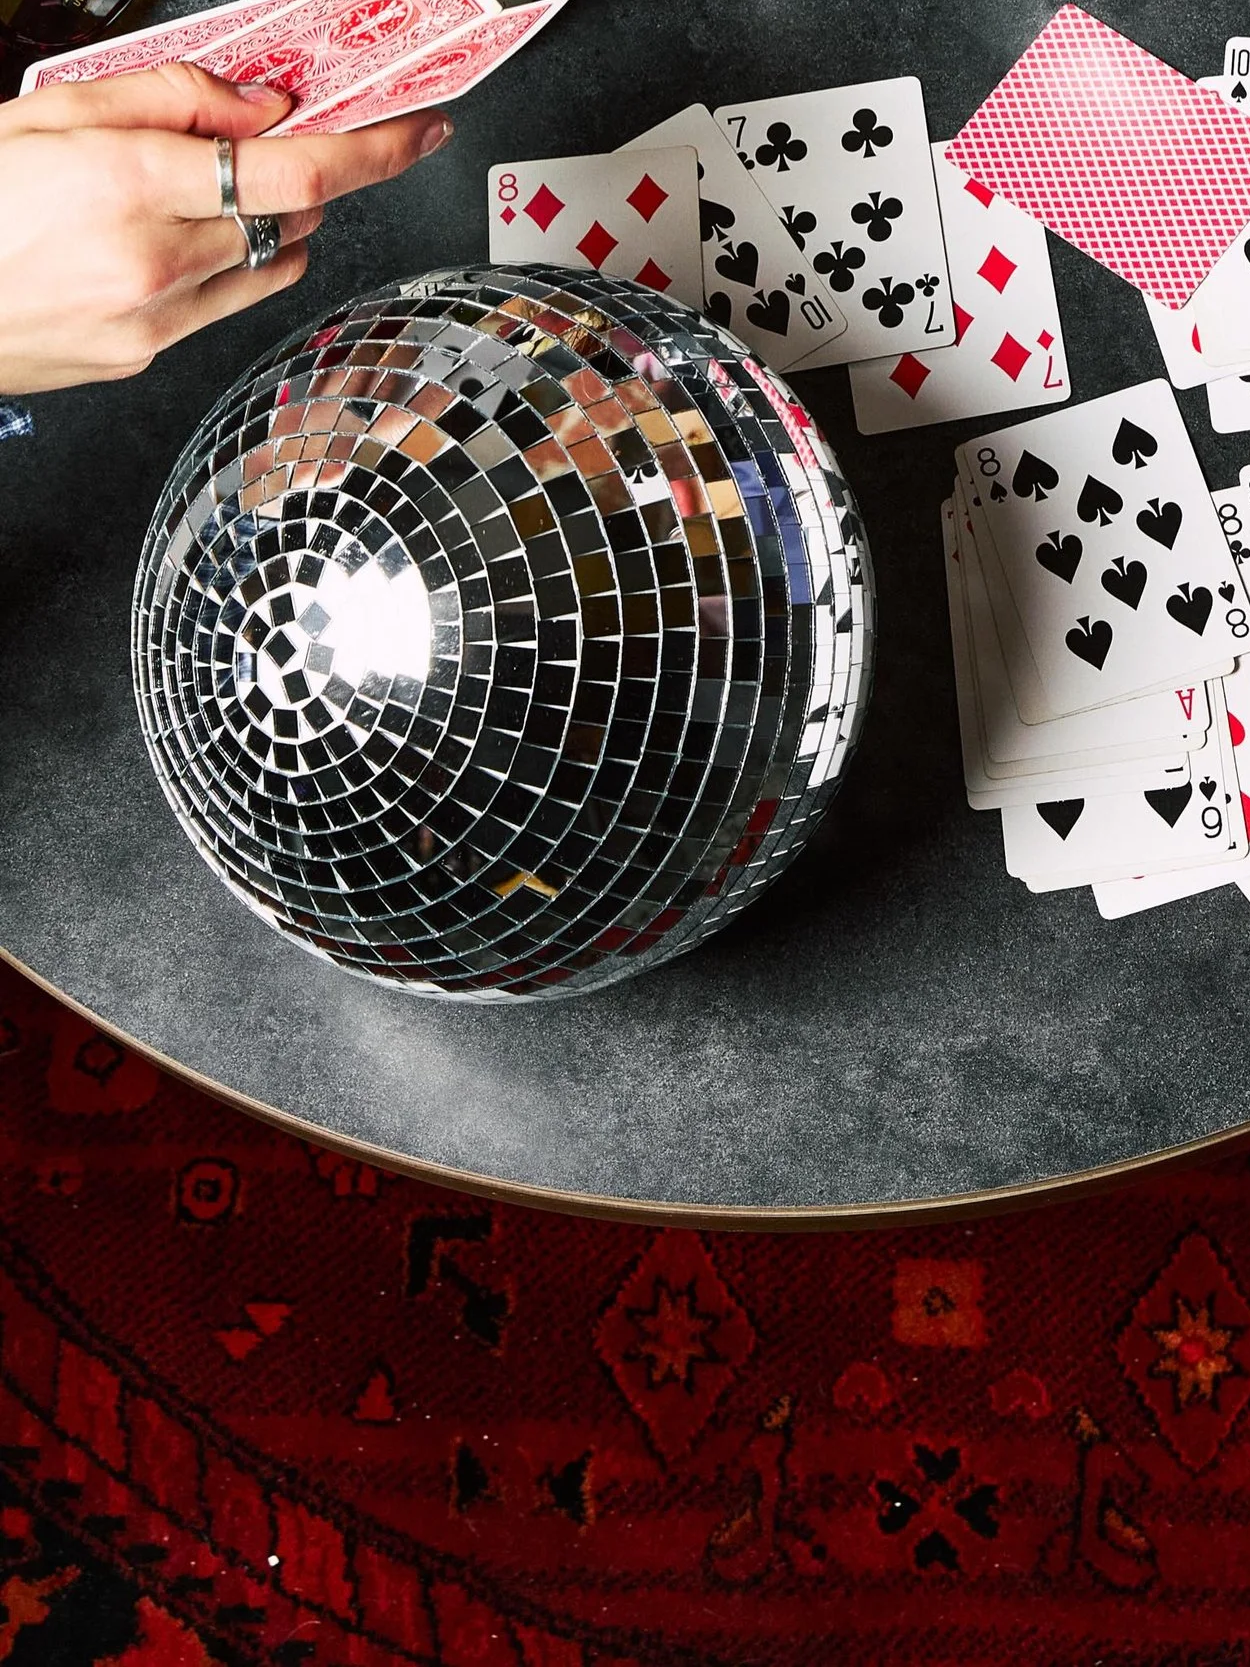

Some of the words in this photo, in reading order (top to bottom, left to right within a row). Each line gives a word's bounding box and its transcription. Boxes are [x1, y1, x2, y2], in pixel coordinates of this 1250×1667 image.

[1230, 48, 1250, 77] 10
[727, 116, 747, 149] 7
[498, 173, 519, 202] 8
[800, 295, 833, 331] 10
[924, 301, 944, 334] 7
[1043, 355, 1063, 389] 7
[977, 447, 1001, 477] 8
[1218, 503, 1243, 535] 8
[1225, 608, 1250, 638] 8
[1175, 688, 1196, 721] A
